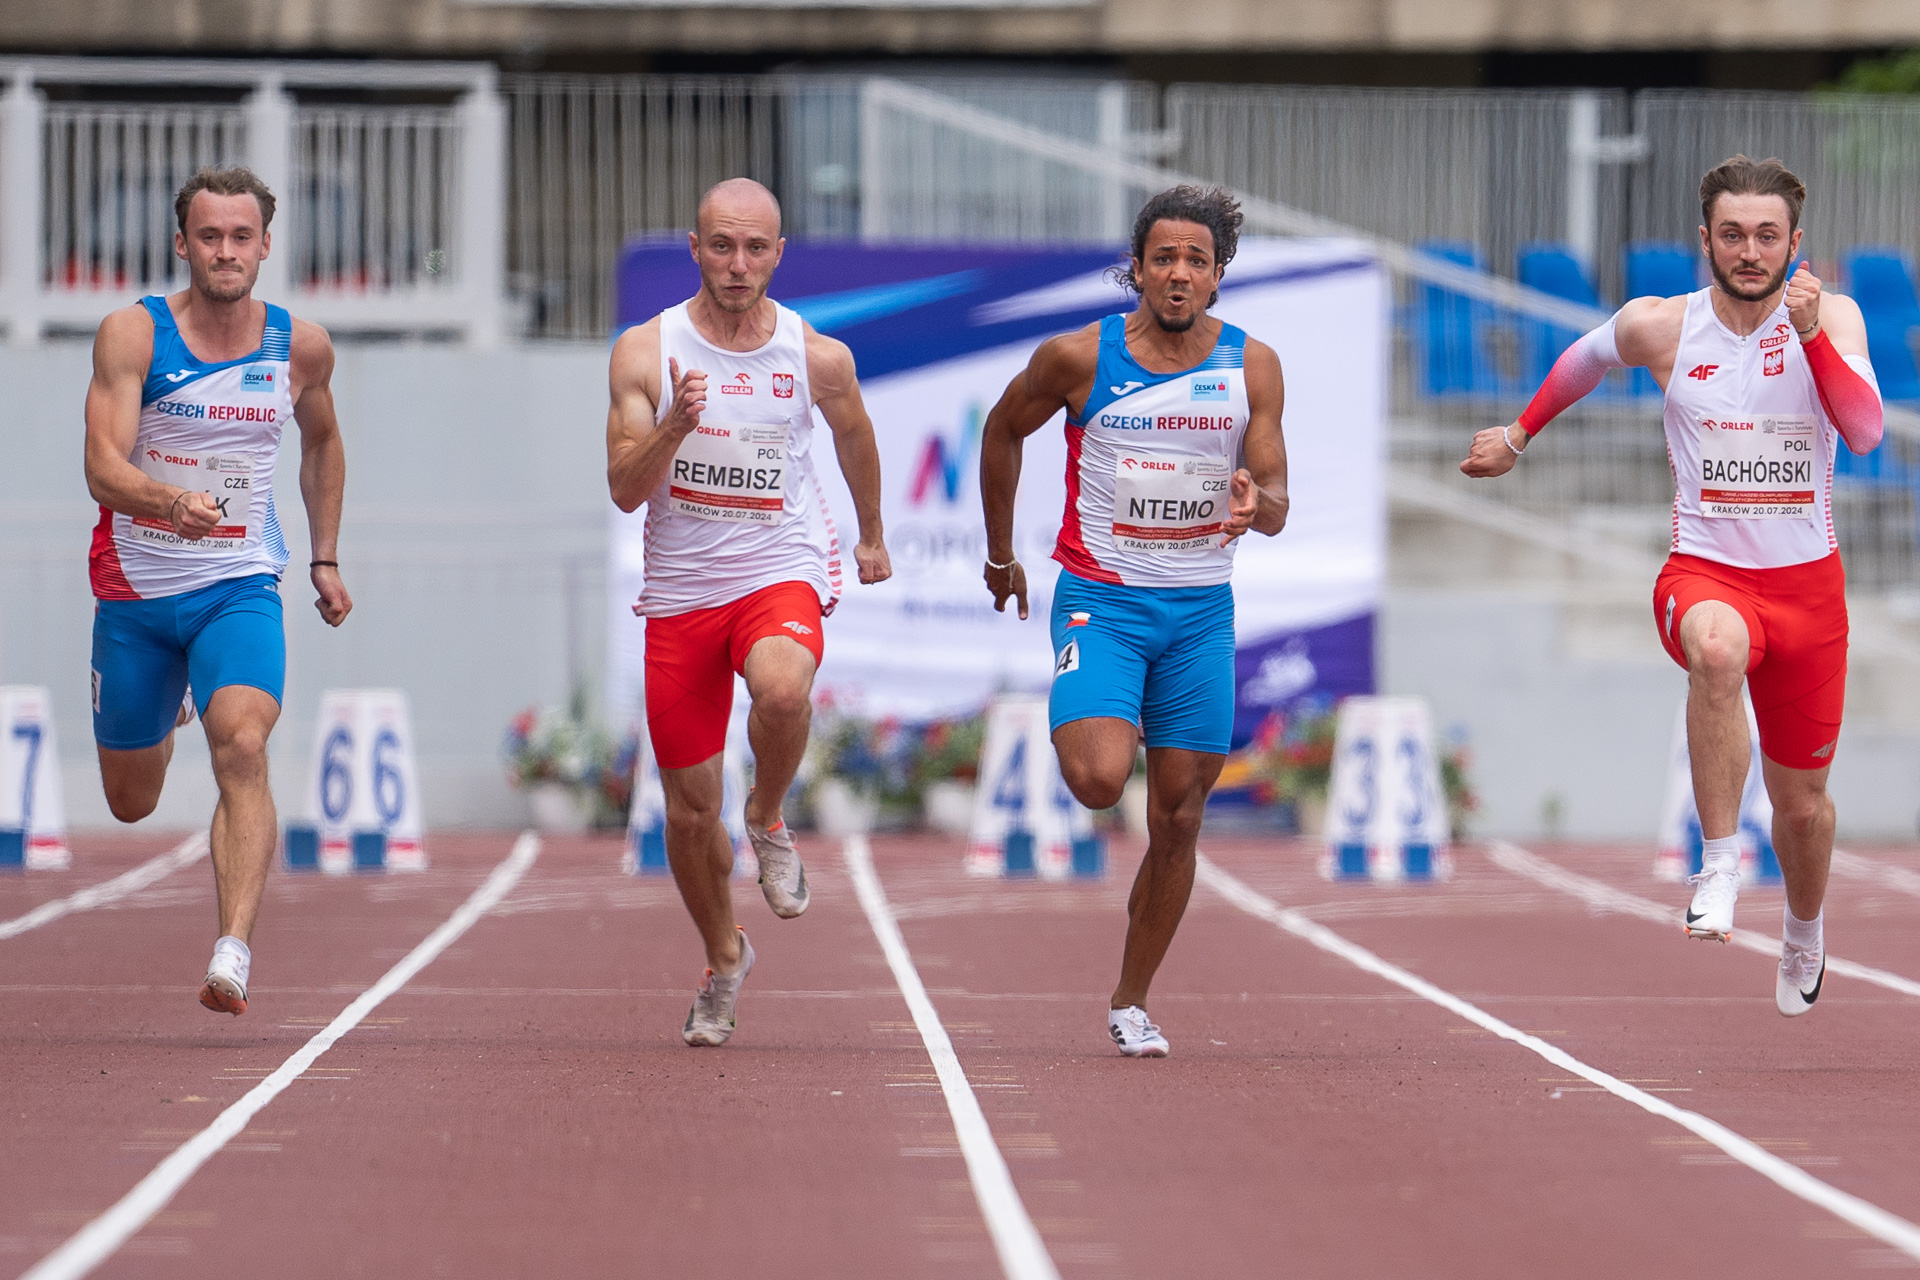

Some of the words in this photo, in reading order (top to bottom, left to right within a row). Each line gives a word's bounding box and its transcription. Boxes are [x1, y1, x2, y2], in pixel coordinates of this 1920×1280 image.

[1761, 335, 1790, 347] ORLEN
[1688, 364, 1719, 381] 4F
[722, 386, 752, 395] ORLEN
[156, 401, 205, 419] CZECH
[208, 405, 276, 423] REPUBLIC
[1100, 414, 1152, 430] CZECH
[1157, 416, 1233, 430] REPUBLIC
[1720, 421, 1754, 431] ORLEN
[696, 426, 731, 438] ORLEN
[757, 448, 782, 460] POL
[1784, 440, 1811, 451] POL
[164, 455, 199, 467] ORLEN
[1141, 461, 1176, 471] ORLEN
[1703, 455, 1811, 483] BACHÓRSKI
[224, 477, 249, 489] CZE
[674, 459, 781, 490] REMBISZ
[1202, 479, 1228, 491] CZE
[680, 502, 720, 517] KRAKÓW
[722, 509, 772, 521] 20.07.2024
[1129, 497, 1215, 521] NTEMO
[1711, 504, 1750, 515] KRAKÓW
[1753, 506, 1803, 515] 20.07.2024
[143, 530, 184, 544] KRAKÓW
[187, 539, 233, 548] 20.07.2024
[1123, 538, 1166, 550] KRAKÓW
[1168, 537, 1210, 550] 20.07.2024
[1056, 644, 1074, 672] 4
[12, 722, 42, 832] 7
[321, 725, 355, 822] 6
[372, 728, 405, 827] 6
[991, 733, 1027, 826] 4
[1341, 736, 1378, 830] 3
[1396, 736, 1429, 830] 3
